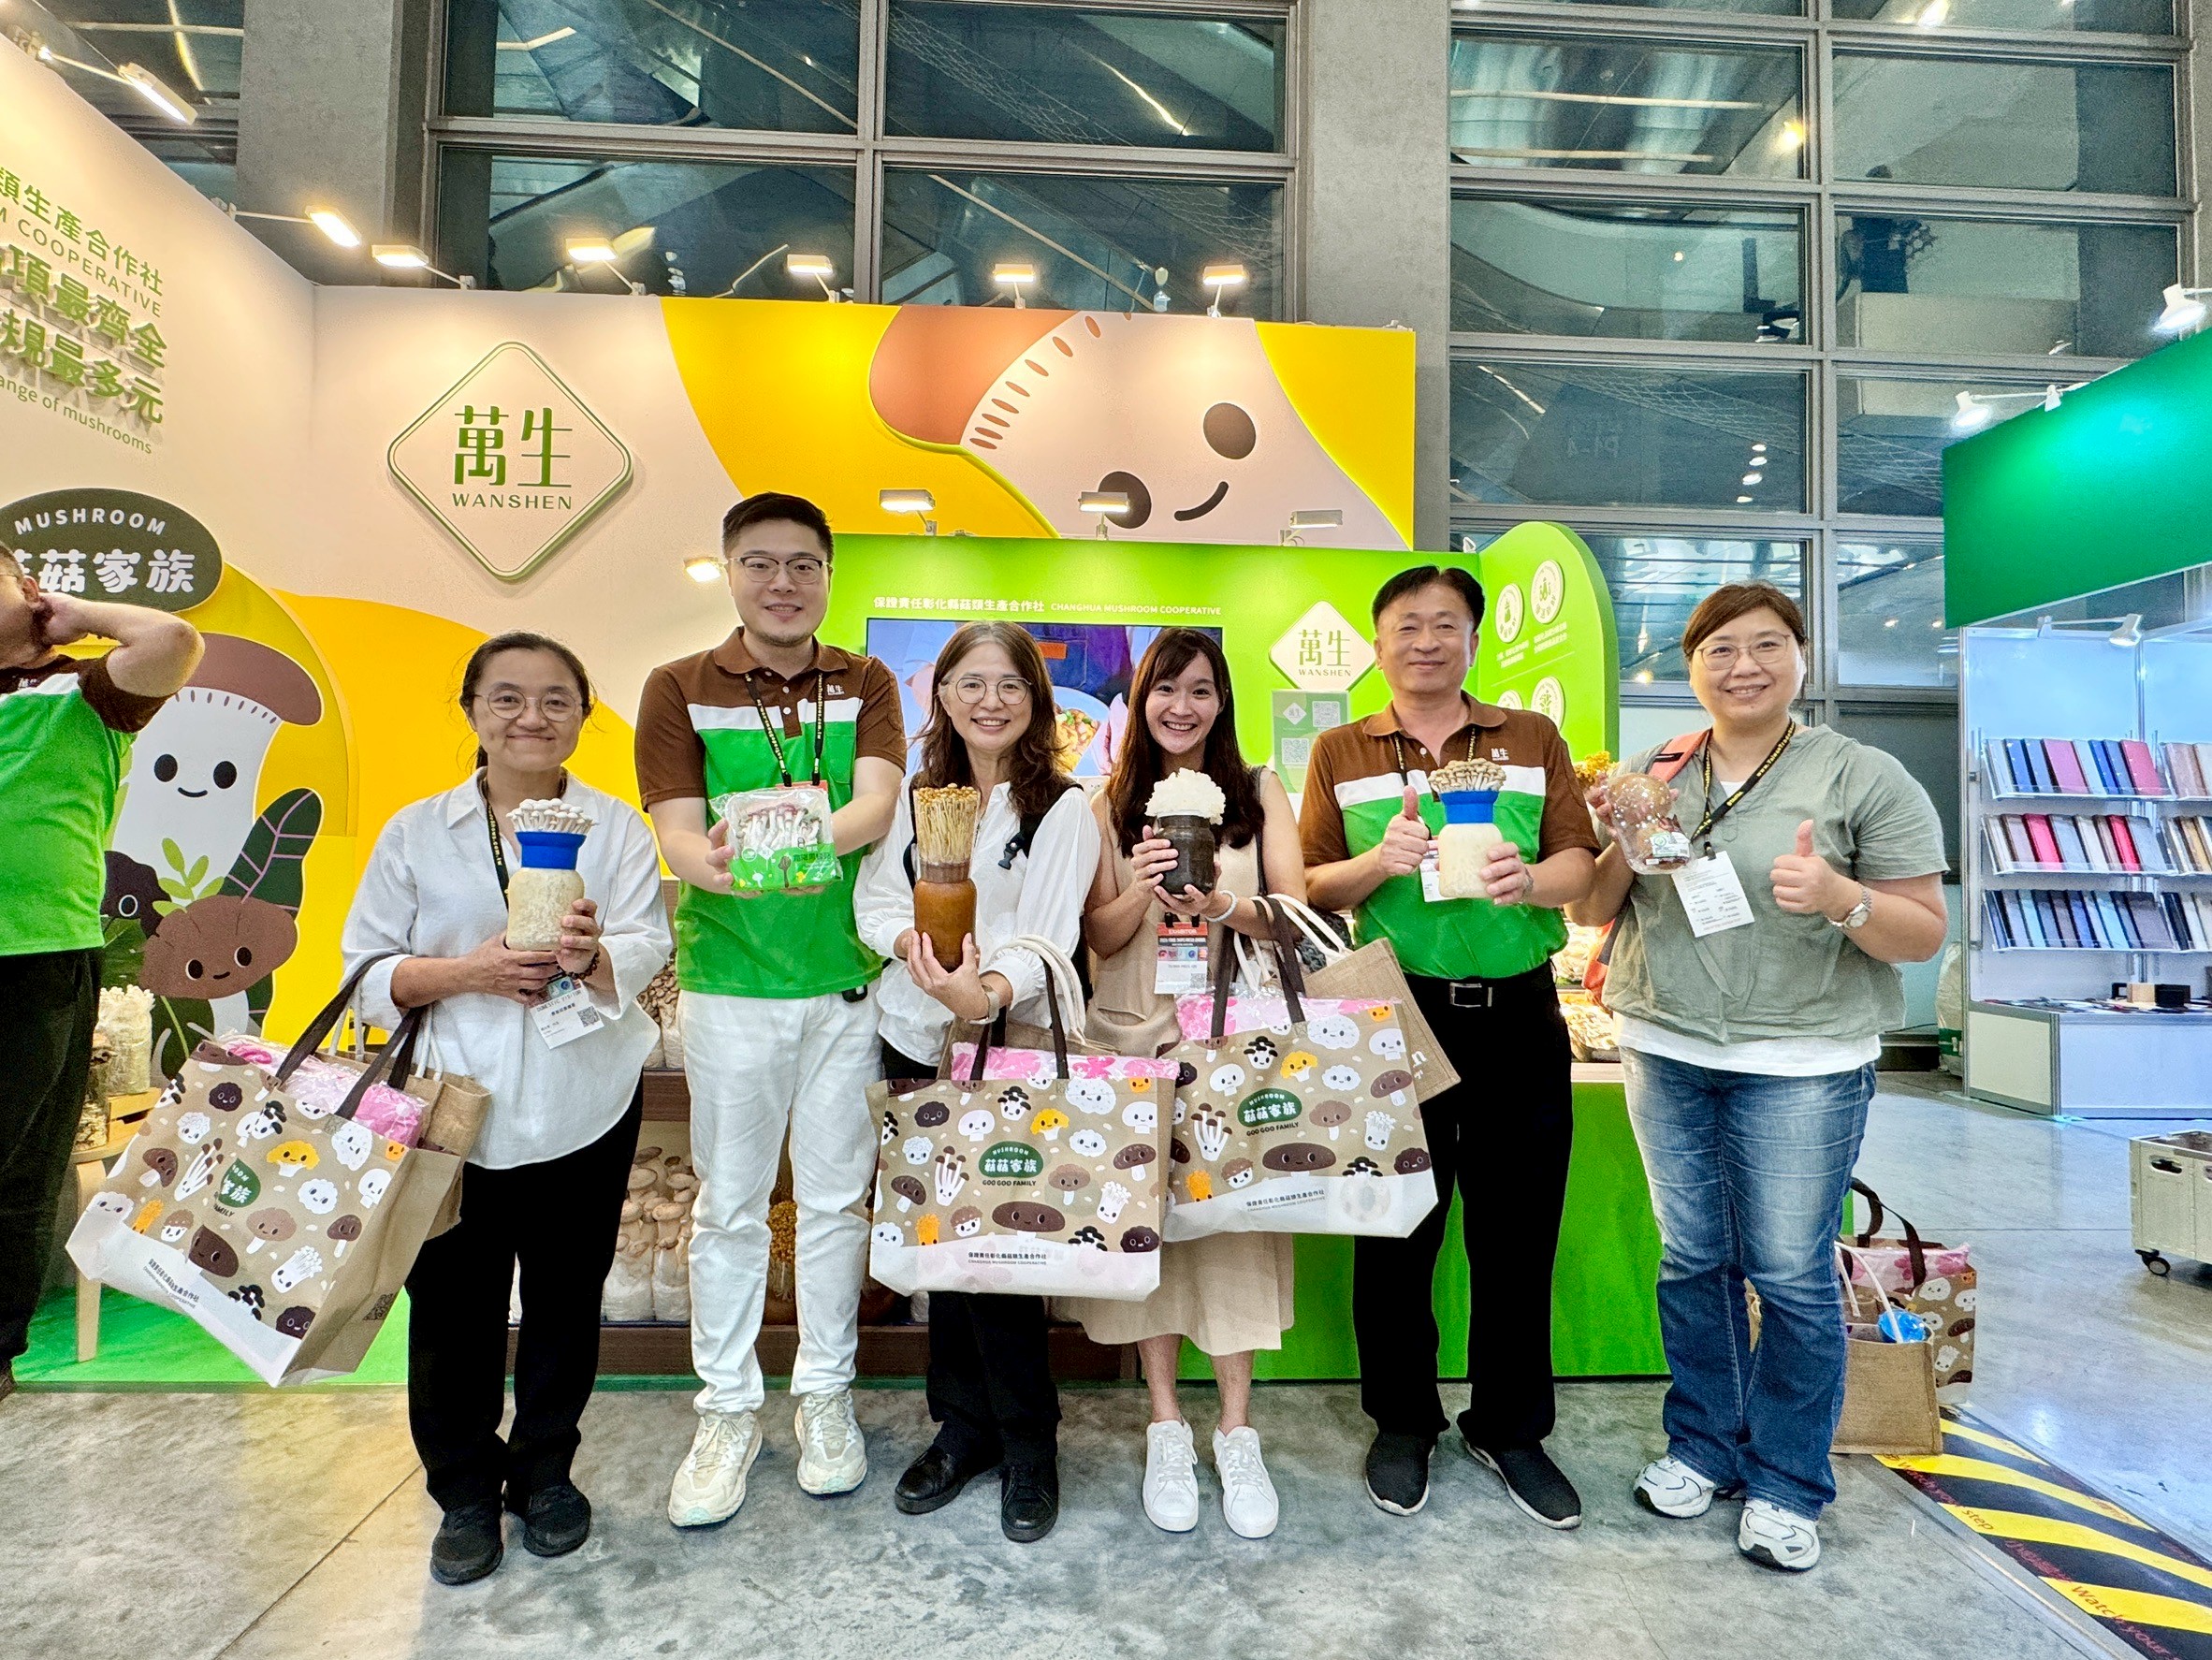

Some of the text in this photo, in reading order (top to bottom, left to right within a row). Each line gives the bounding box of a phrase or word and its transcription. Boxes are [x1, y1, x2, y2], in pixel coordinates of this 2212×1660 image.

[18, 219, 161, 318] COOPERATIVE
[42, 397, 60, 412] of
[63, 404, 152, 454] mushrooms
[454, 405, 573, 488] 萬生
[452, 493, 573, 510] WANSHEN
[14, 508, 166, 535] MUSHROOM
[1051, 603, 1221, 615] CHANGHUA MUSHROOM COOPERATIVE
[1298, 629, 1350, 666] 萬生
[1276, 1122, 1299, 1130] FAMILY
[1962, 1508, 1994, 1531] step
[2072, 1585, 2127, 1625] Watch
